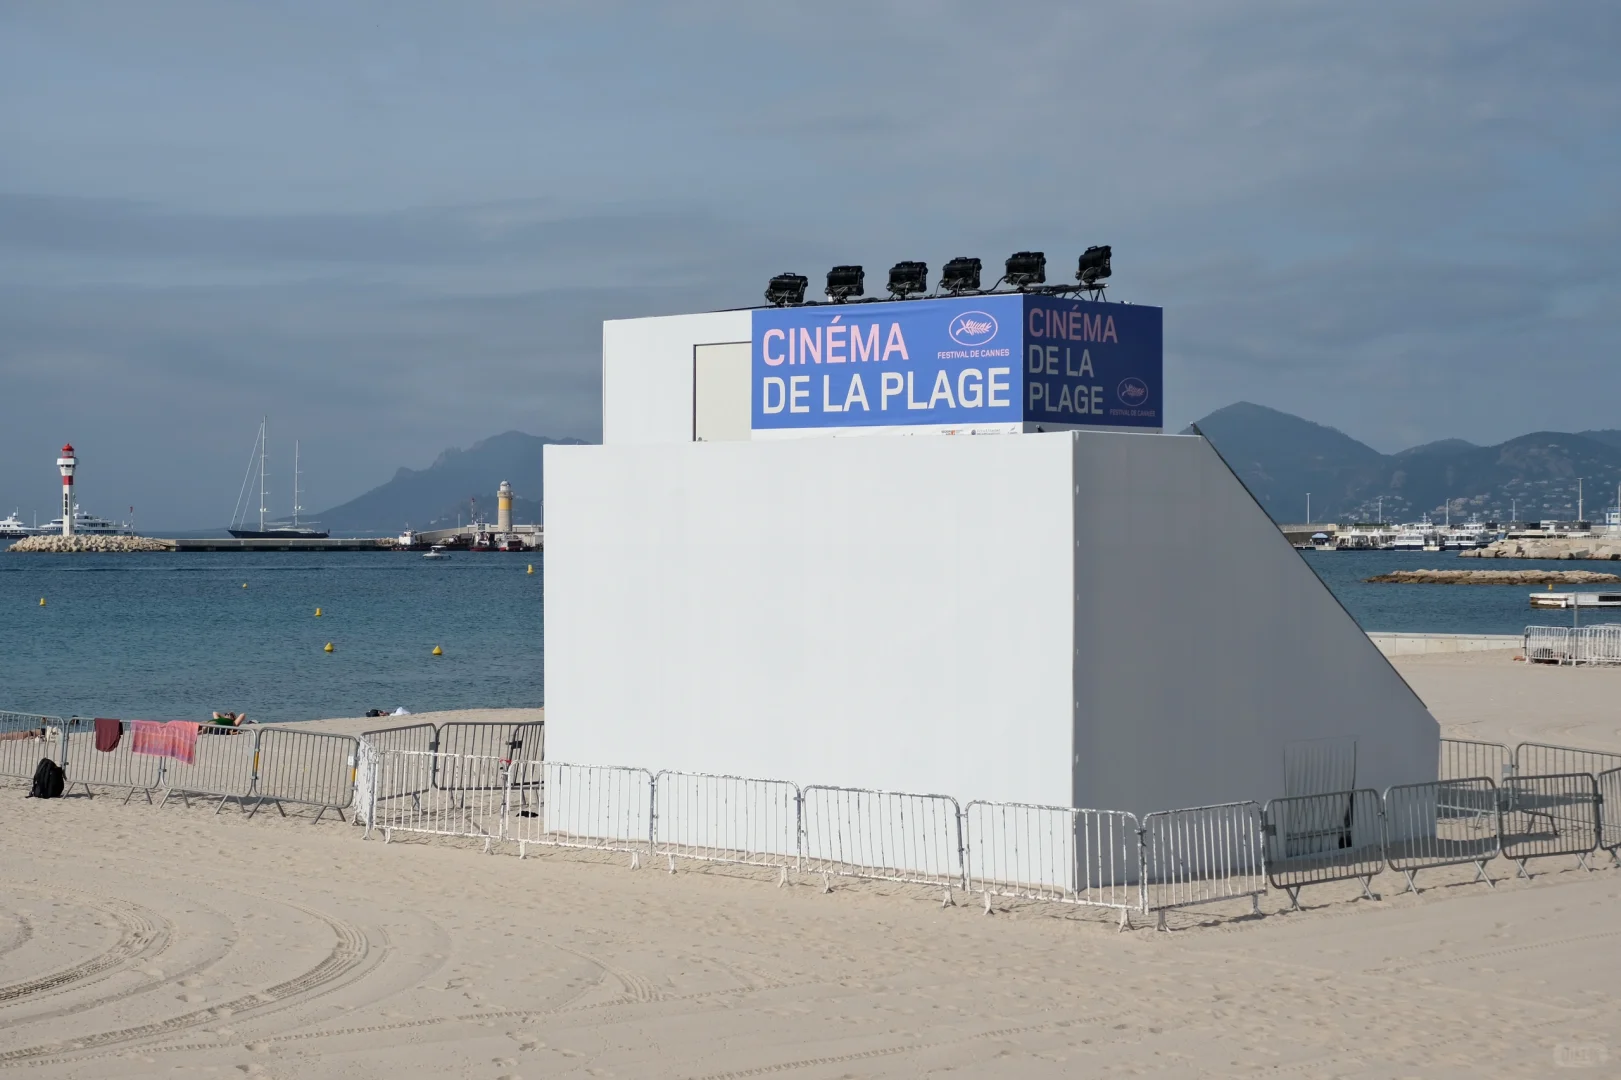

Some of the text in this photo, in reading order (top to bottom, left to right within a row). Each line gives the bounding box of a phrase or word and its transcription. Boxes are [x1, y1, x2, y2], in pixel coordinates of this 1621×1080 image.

[762, 315, 909, 366] CINÉMA
[1028, 304, 1118, 344] CINÉMA
[937, 348, 1010, 359] FESTIVAL DE CANNES
[1028, 344, 1095, 378] DE LA
[763, 367, 1011, 414] DE LA PLAGE
[1029, 381, 1104, 415] PLAGE
